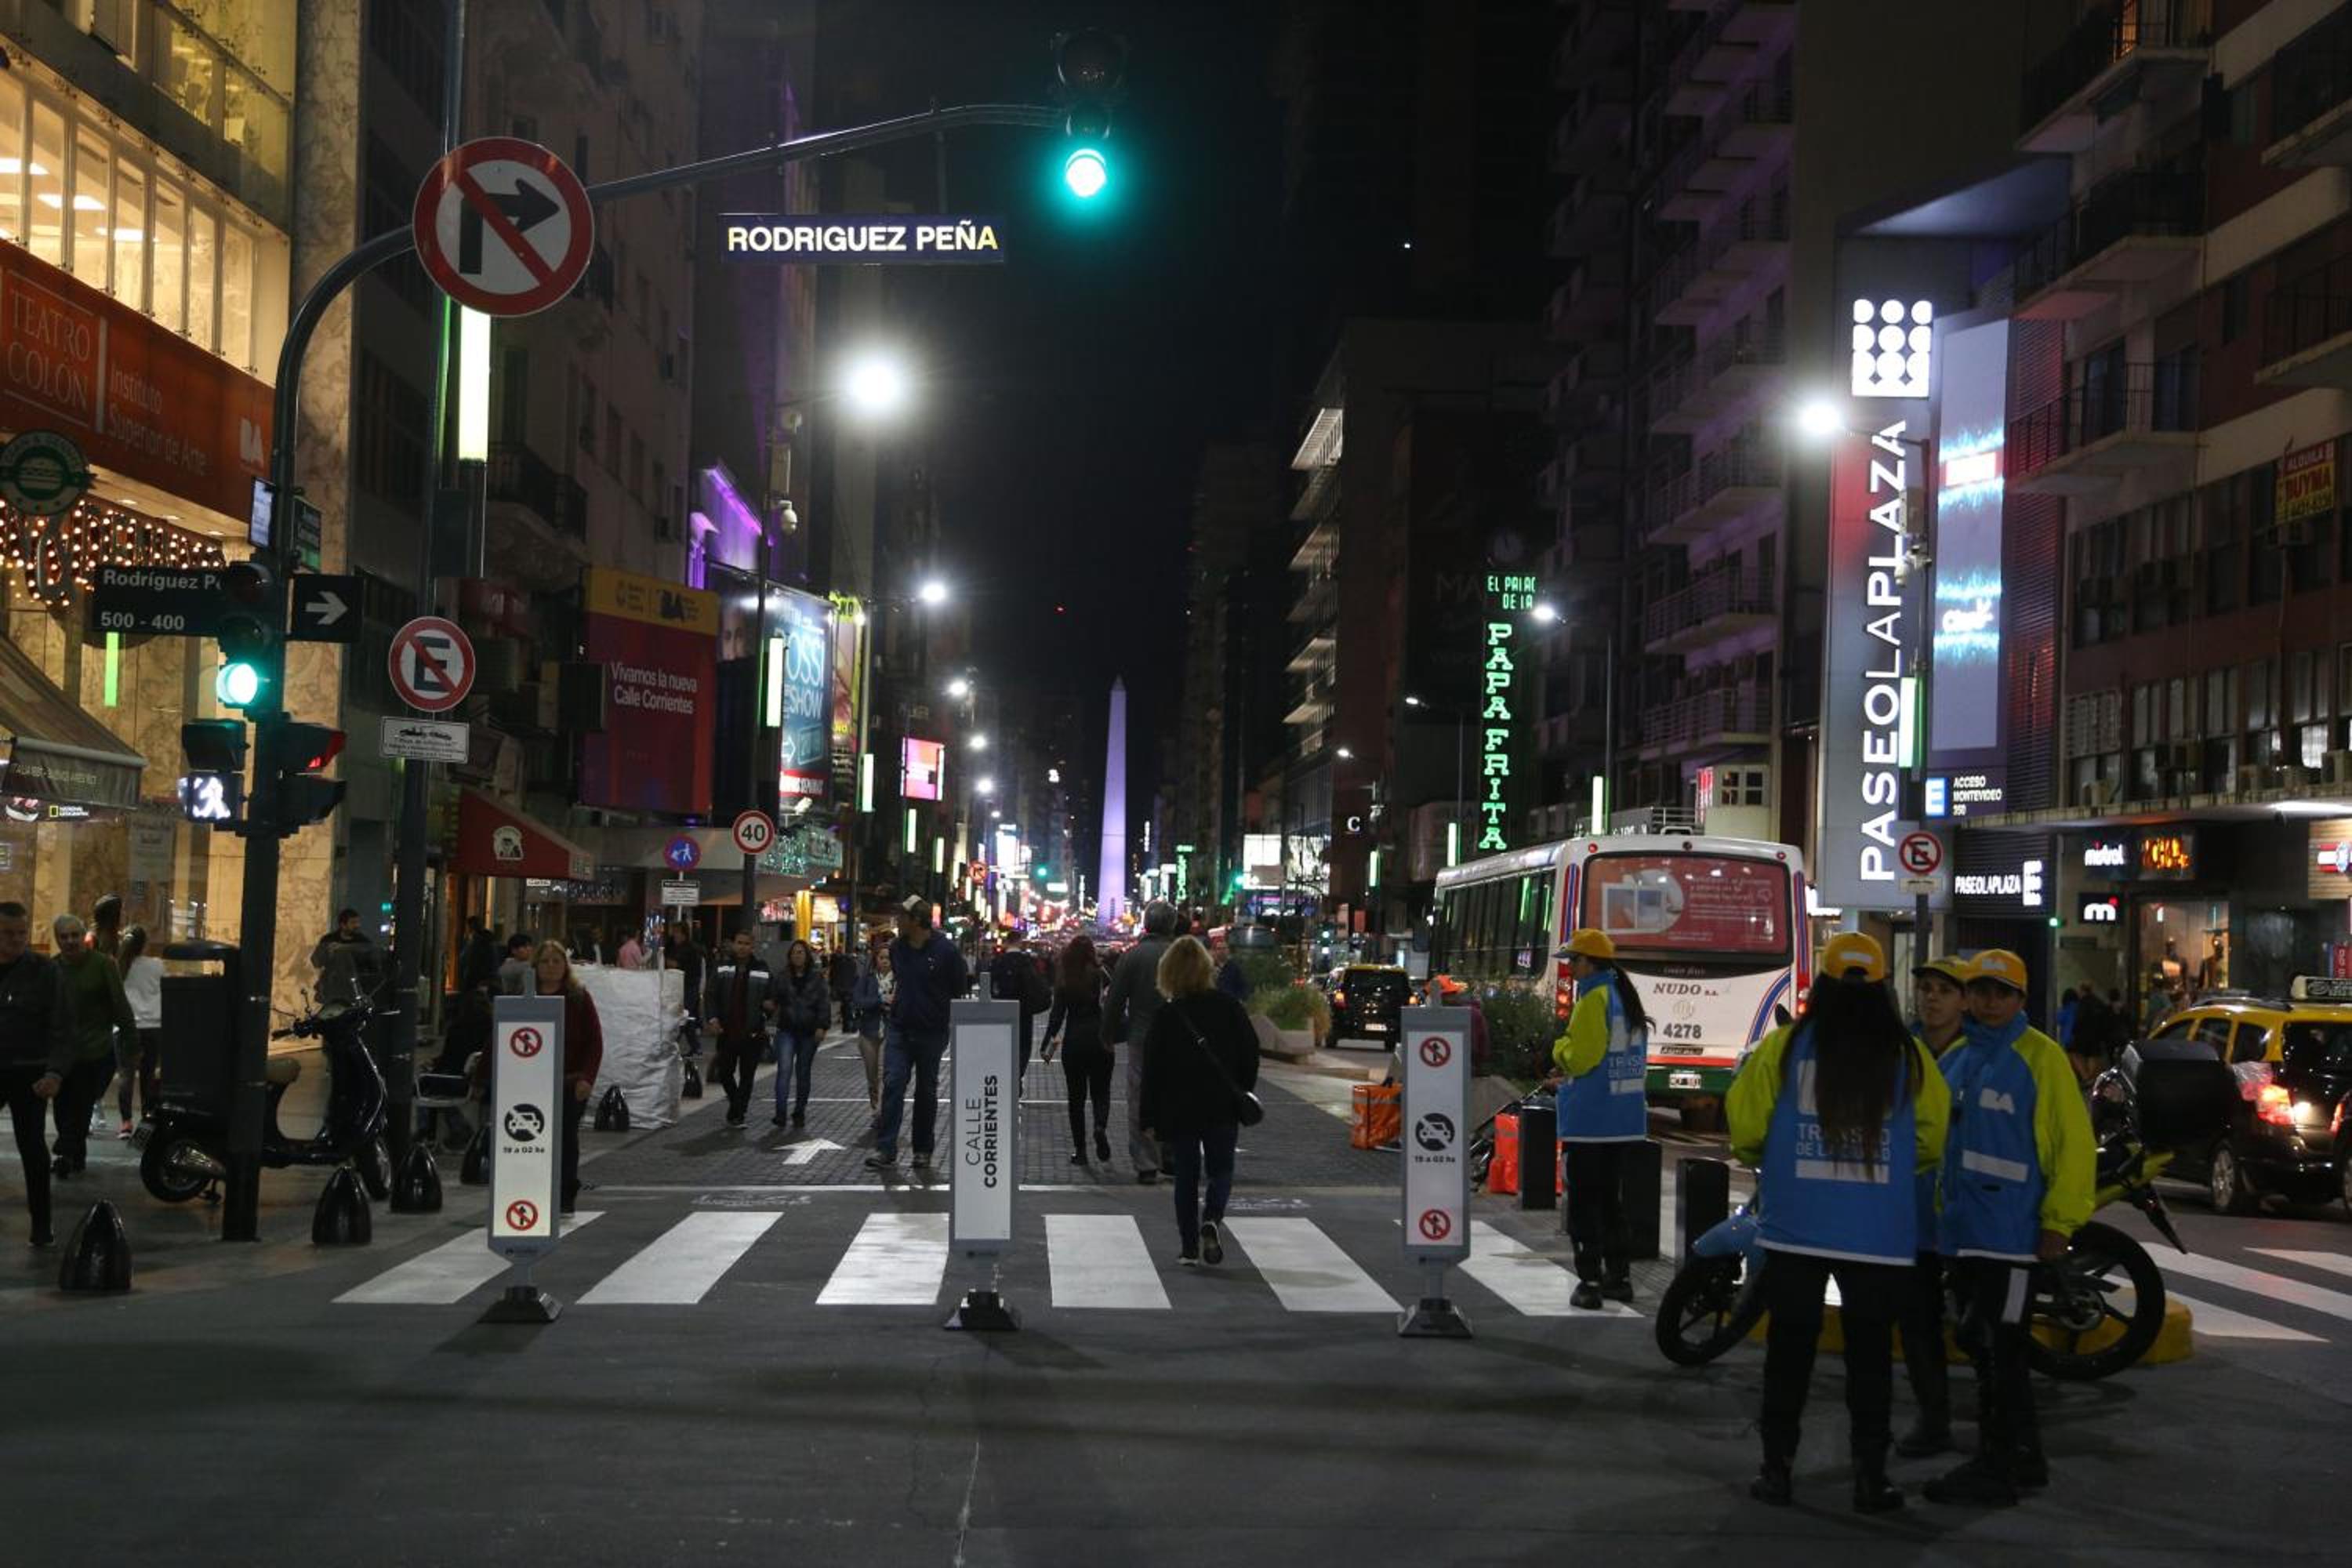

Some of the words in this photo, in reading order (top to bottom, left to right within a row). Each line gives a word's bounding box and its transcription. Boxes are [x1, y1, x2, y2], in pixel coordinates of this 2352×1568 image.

[728, 226, 907, 252] RODRIGUEZ
[916, 220, 998, 251] PEÑA
[12, 288, 90, 362] TEATRO
[107, 402, 163, 455] Superior
[103, 568, 199, 591] Rodríguez
[1487, 575, 1499, 592] EL
[1503, 593, 1516, 609] DE
[100, 611, 135, 628] 500
[151, 614, 185, 631] 400
[609, 661, 657, 687] Vivamos
[658, 668, 666, 688] la
[668, 673, 698, 695] nueva
[1482, 622, 1514, 721] PAPA
[614, 684, 641, 707] Calle
[642, 688, 695, 715] Corrientes
[789, 684, 823, 720] SHOW
[1478, 727, 1511, 851] FRITA
[1953, 775, 1986, 788] ACCESO
[1953, 789, 2002, 802] MONTEVIDEO
[741, 824, 766, 842] 40
[1653, 982, 1701, 996] NUDO
[1662, 1022, 1702, 1040] 4278
[965, 1097, 982, 1166] CALLE
[984, 1074, 998, 1189] CORRIENTES
